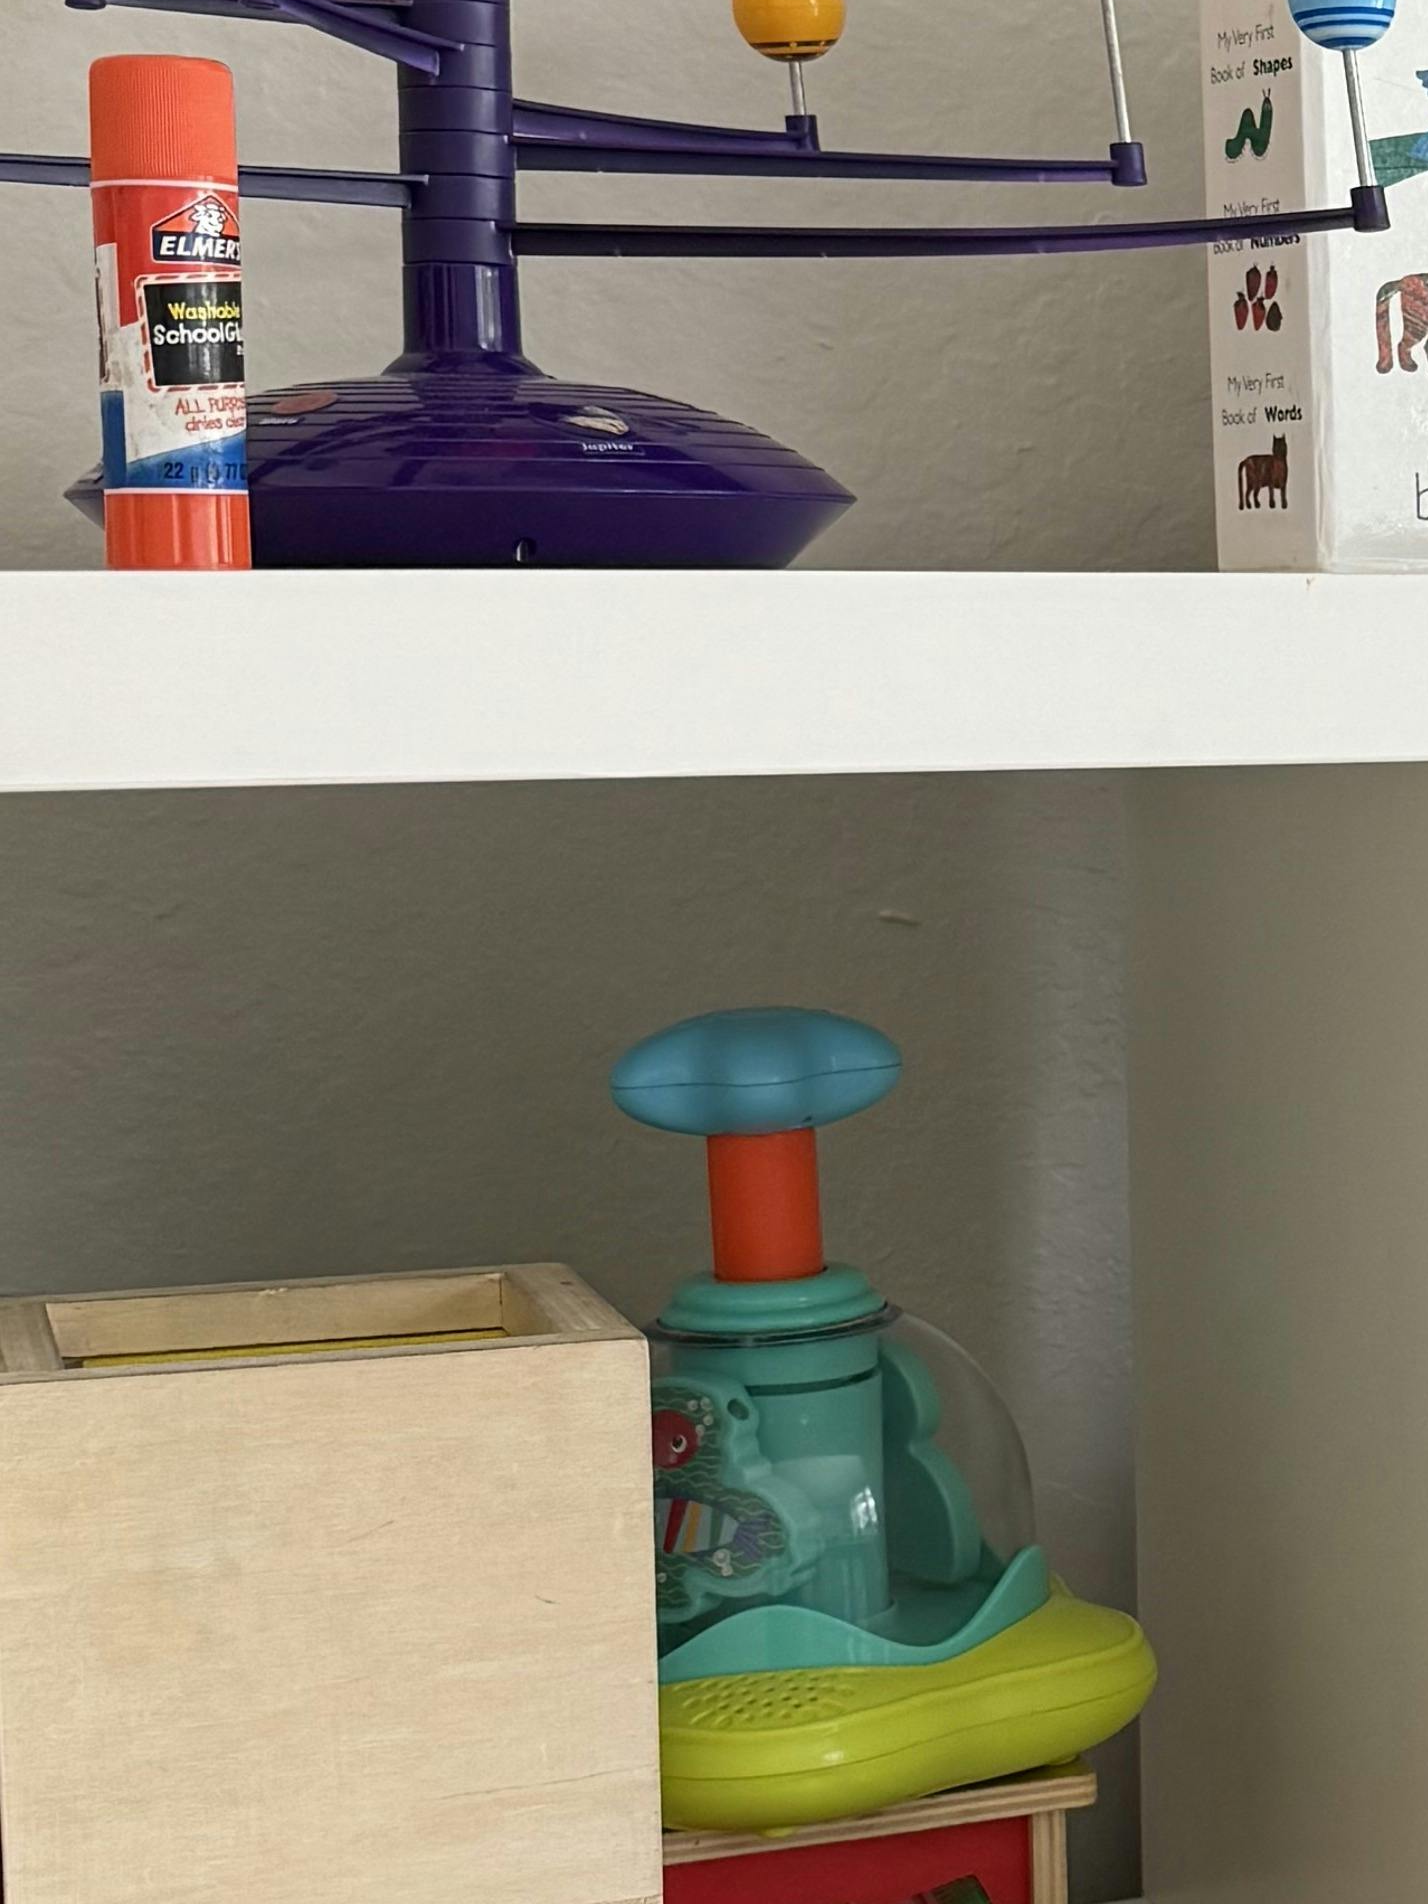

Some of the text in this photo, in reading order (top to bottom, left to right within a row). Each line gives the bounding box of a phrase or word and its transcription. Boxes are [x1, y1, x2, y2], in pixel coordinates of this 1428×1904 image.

[1217, 23, 1275, 53] My Very First
[1210, 55, 1293, 85] Book of Shapes
[1261, 197, 1281, 214] First
[1250, 234, 1301, 250] Numbers
[153, 322, 224, 346] School
[1226, 372, 1285, 396] My Very First
[175, 397, 206, 415] ALL
[1221, 404, 1302, 426] Book of Words
[163, 462, 185, 479] 22
